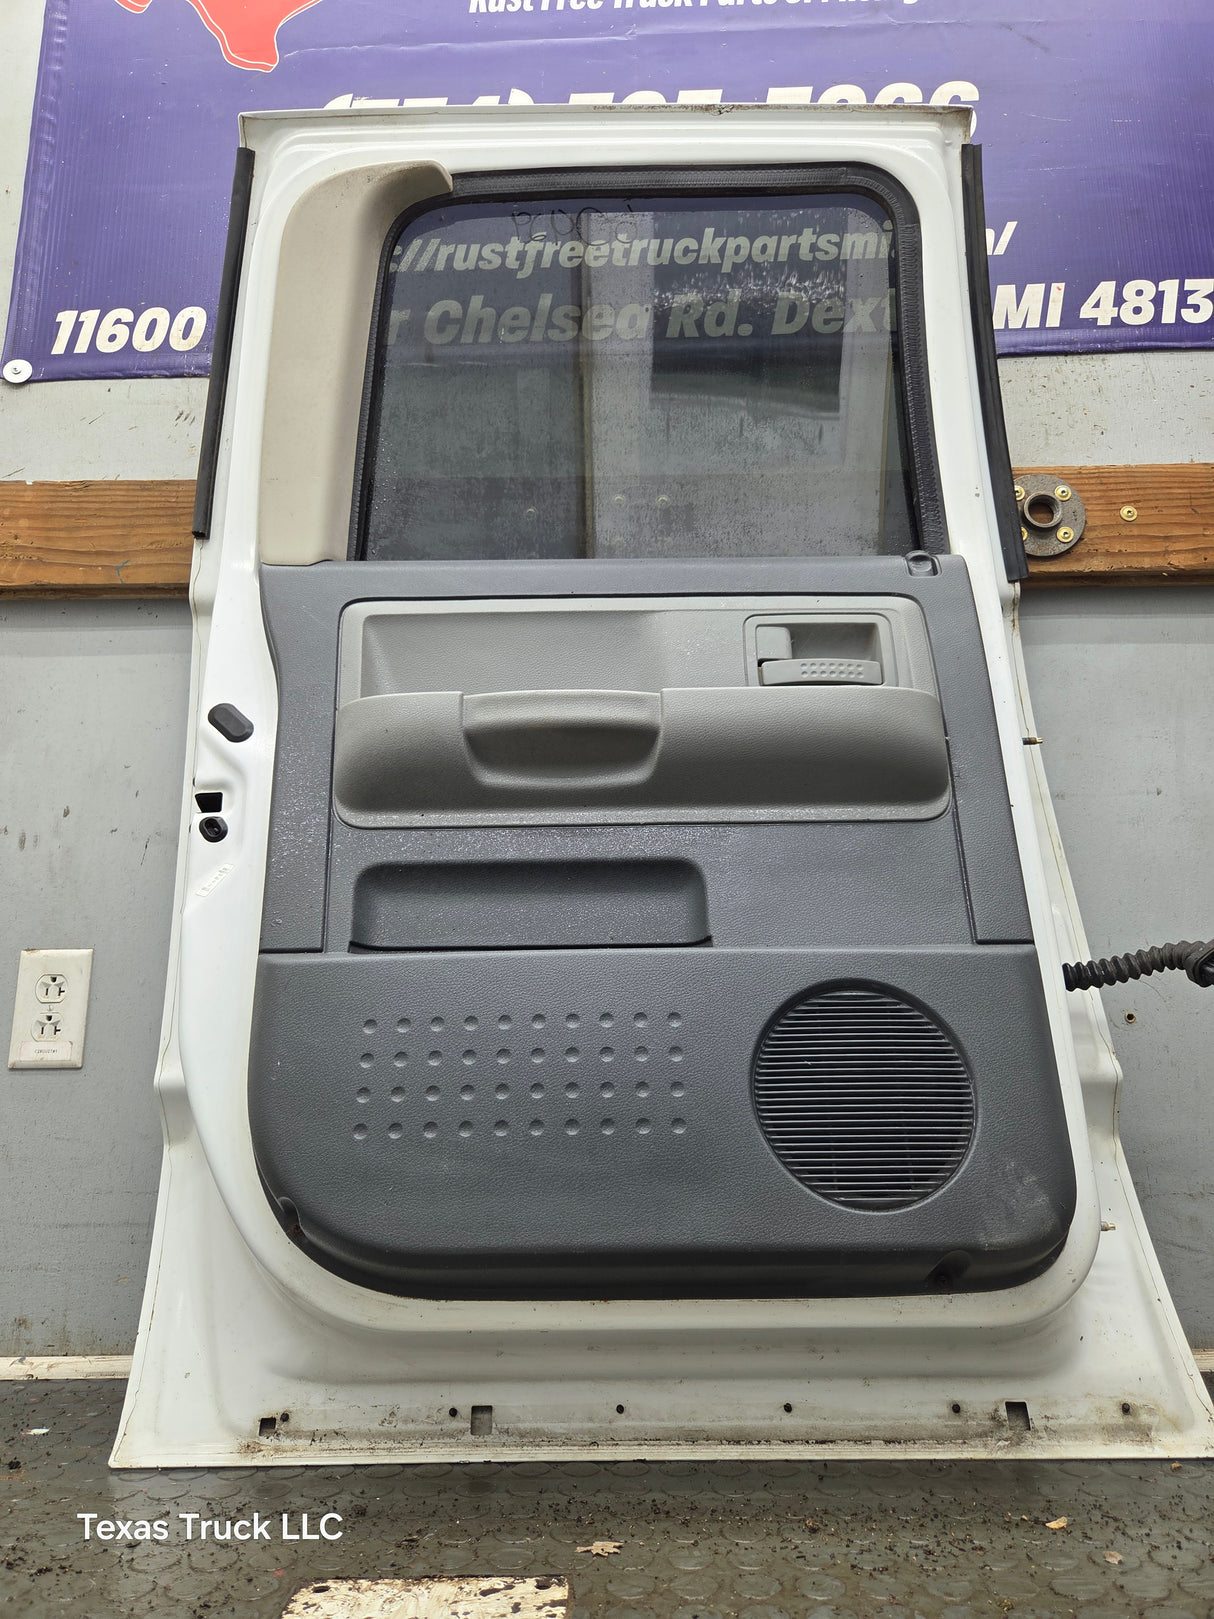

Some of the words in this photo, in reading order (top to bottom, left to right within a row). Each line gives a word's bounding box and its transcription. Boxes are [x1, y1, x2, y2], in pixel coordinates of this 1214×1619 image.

[51, 306, 207, 354] 11600
[424, 293, 652, 344] Chelsea
[666, 289, 753, 338] Rd.
[992, 282, 1065, 329] MI
[1080, 278, 1214, 325] 4813
